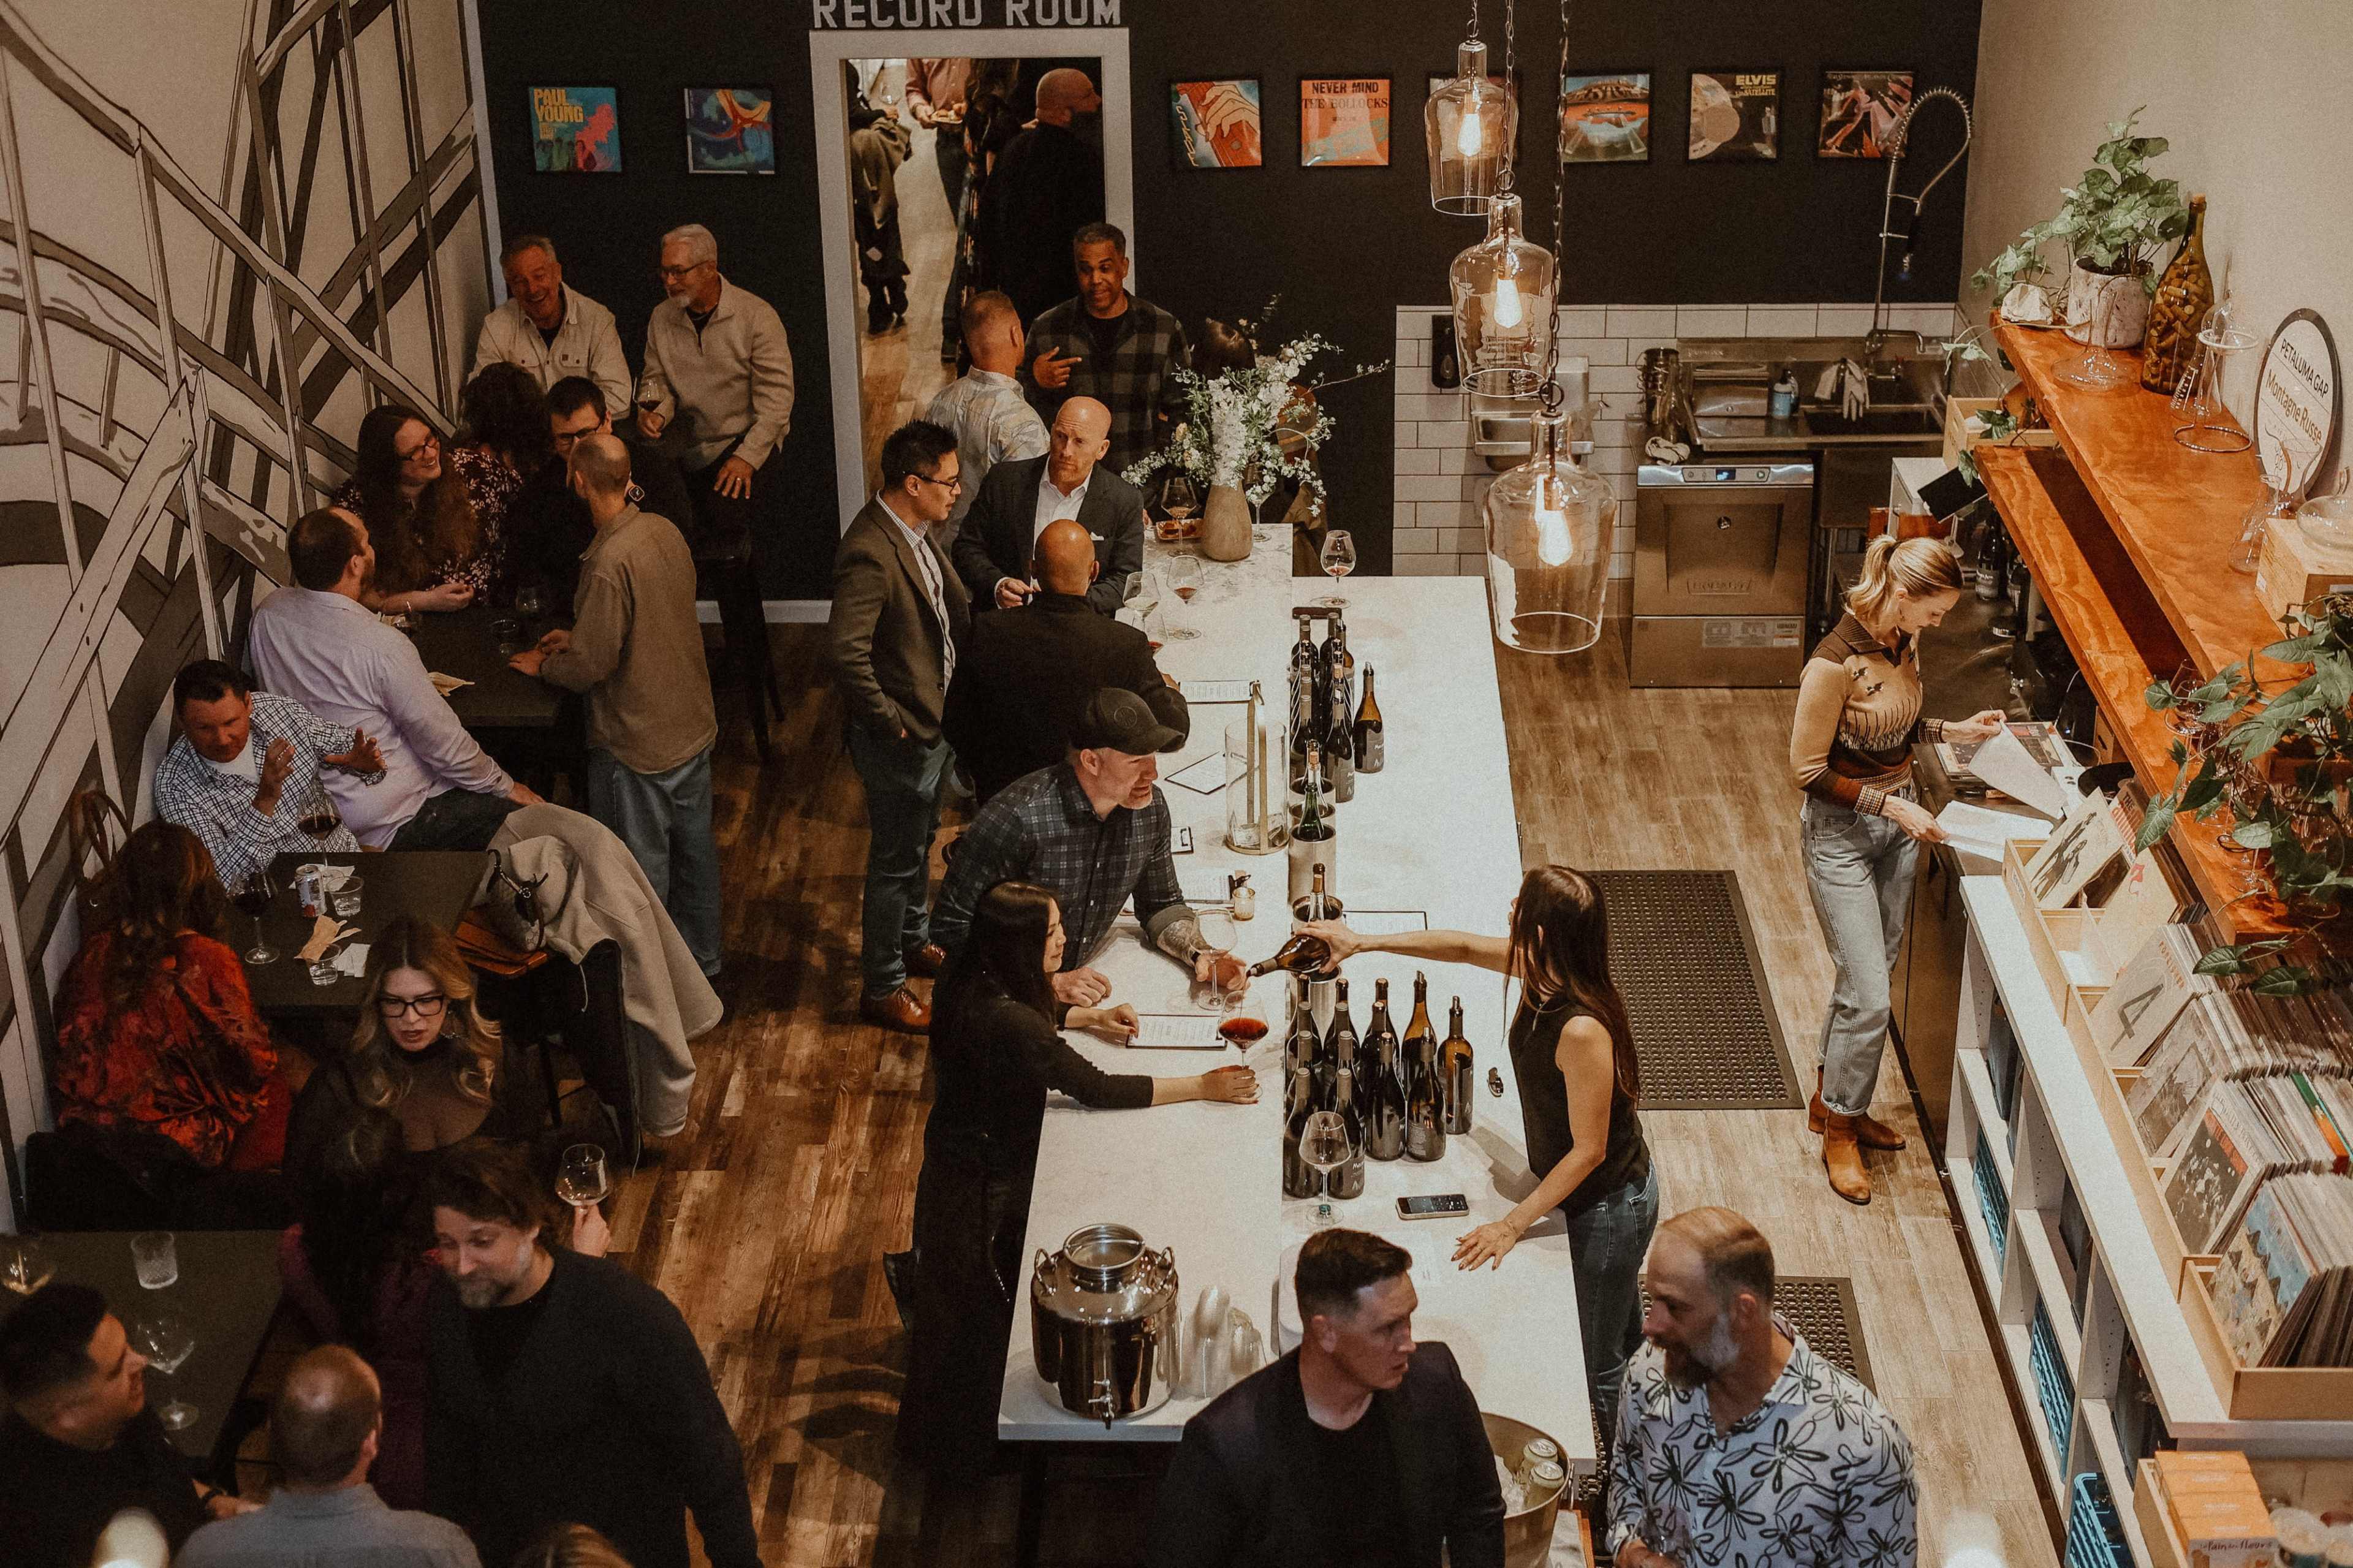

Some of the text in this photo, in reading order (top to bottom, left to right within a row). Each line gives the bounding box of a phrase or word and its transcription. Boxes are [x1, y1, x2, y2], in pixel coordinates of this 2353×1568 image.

[813, 0, 1121, 28] RECORD ROOM
[1312, 81, 1379, 94] NEVER MIND
[1735, 75, 1776, 85] ELVIS
[534, 88, 569, 107] PAUL
[1303, 97, 1388, 108] THE BOLLOCKS
[536, 105, 583, 122] YOUNG
[2280, 338, 2328, 398] PETALUMA GAP
[2265, 369, 2322, 442] Montagne Russe
